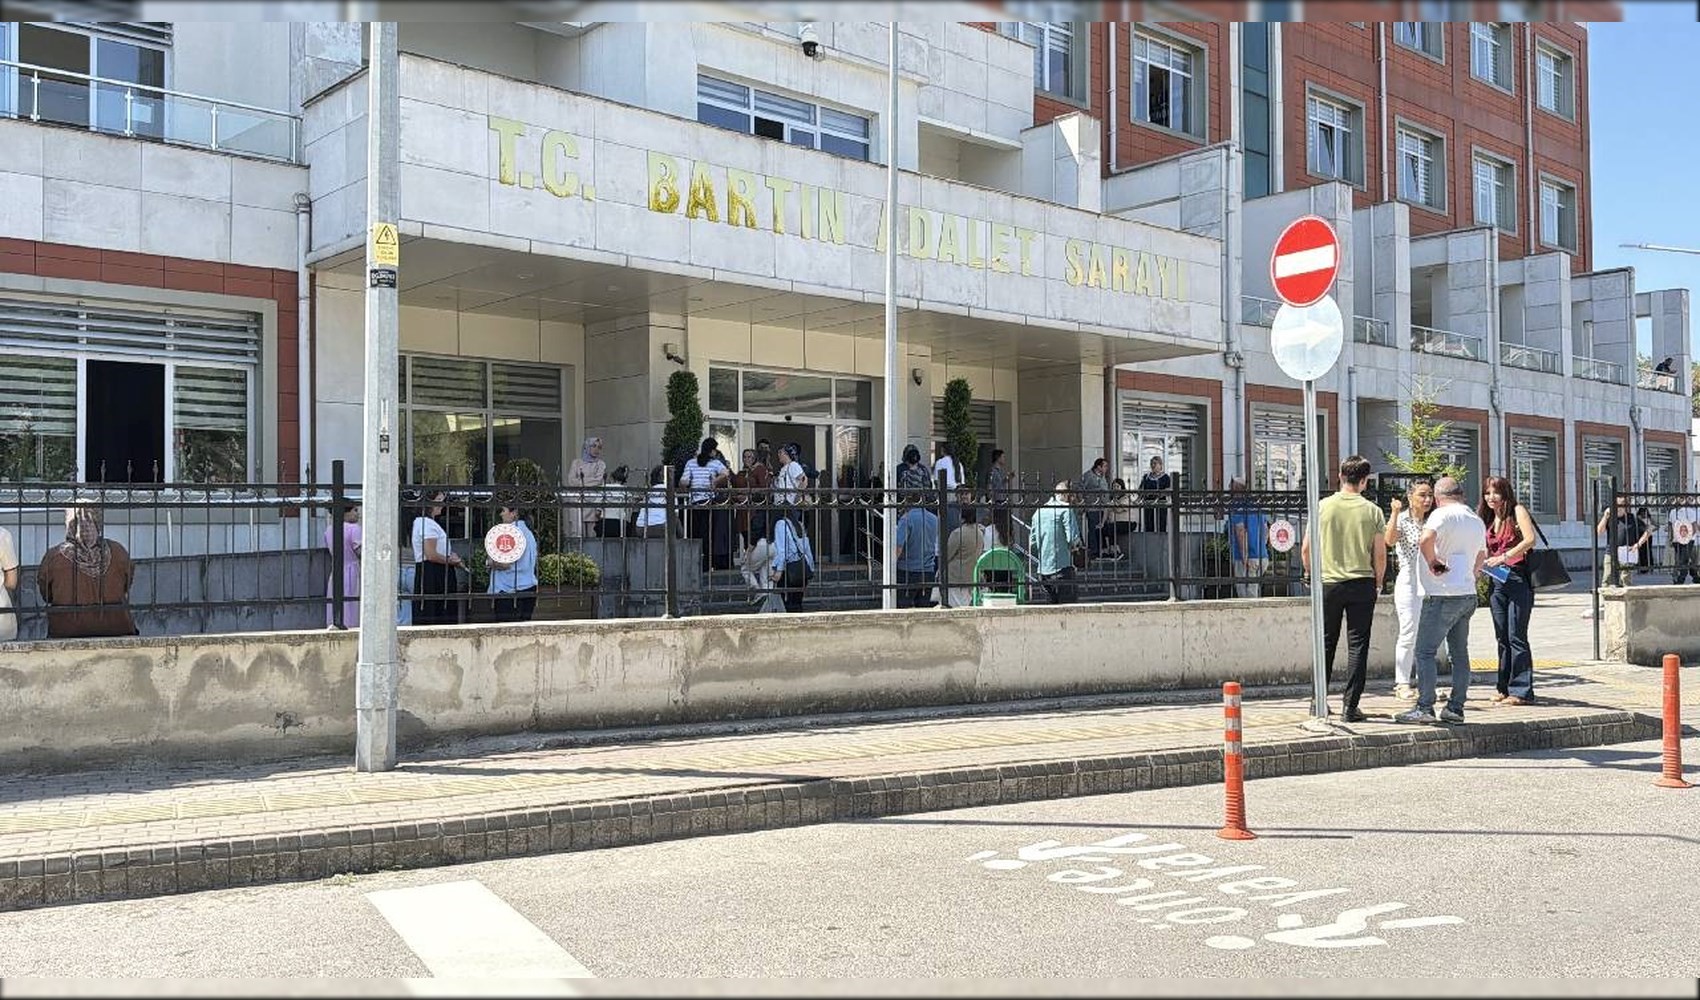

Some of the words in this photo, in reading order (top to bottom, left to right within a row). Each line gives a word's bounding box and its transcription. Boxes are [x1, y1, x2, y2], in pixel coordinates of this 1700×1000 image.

[489, 115, 596, 201] T.C.
[647, 149, 845, 245] BARTIN
[1063, 237, 1188, 302] SARAYI
